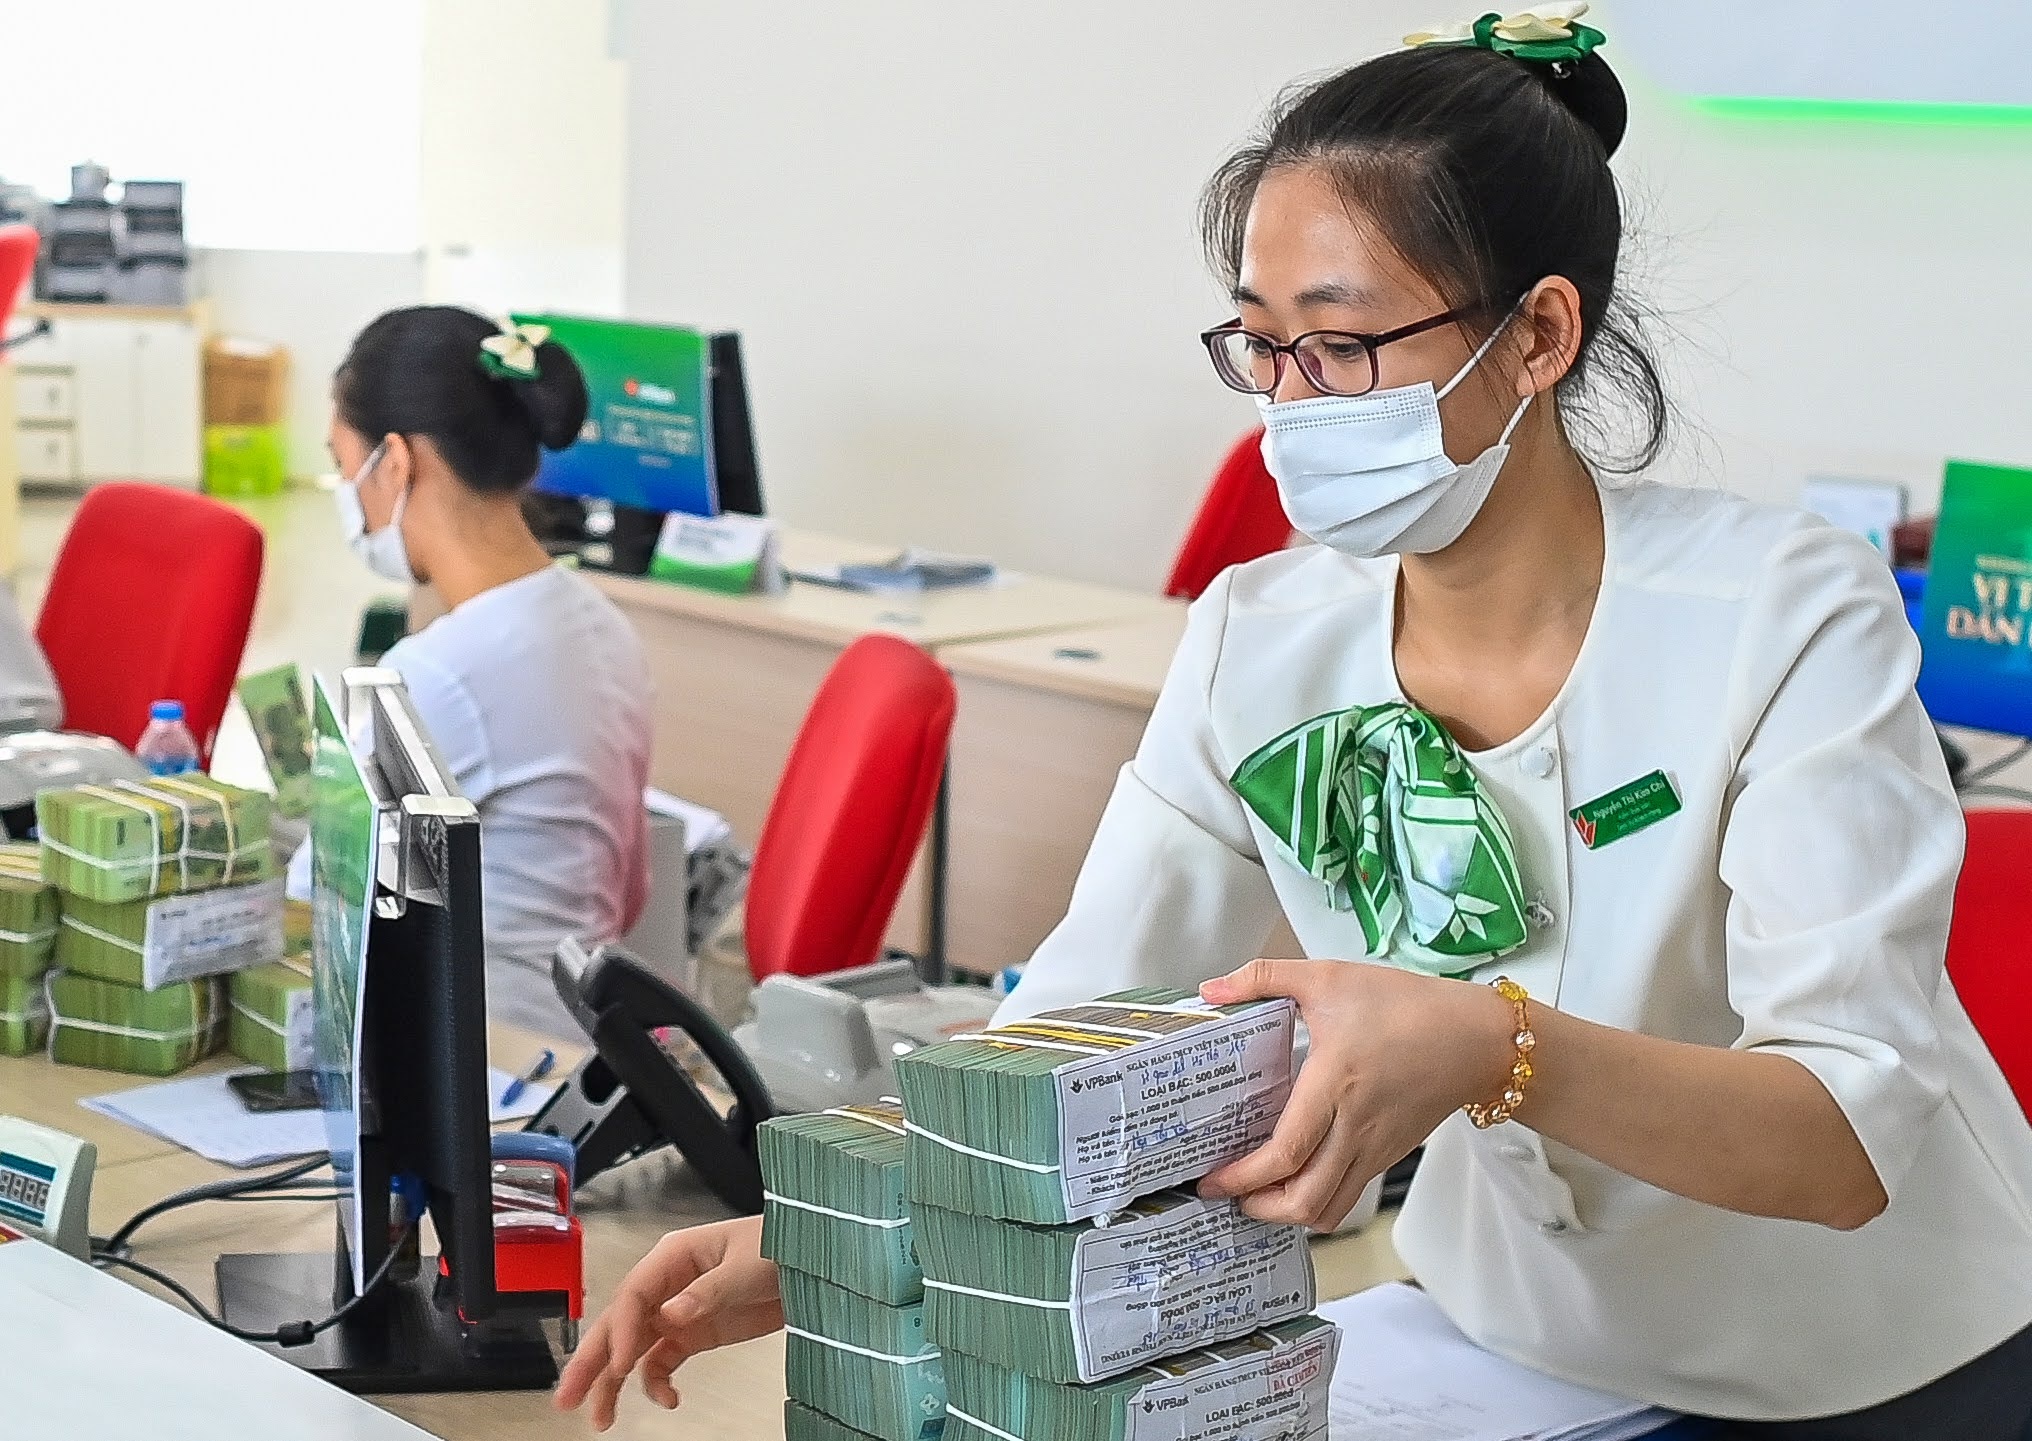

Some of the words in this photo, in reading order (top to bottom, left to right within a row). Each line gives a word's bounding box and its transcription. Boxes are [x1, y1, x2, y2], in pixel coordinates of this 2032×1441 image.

[1085, 1071, 1123, 1090] VPBank
[1141, 1085, 1166, 1100] LOẠI
[1196, 1062, 1236, 1083] 500.000đ
